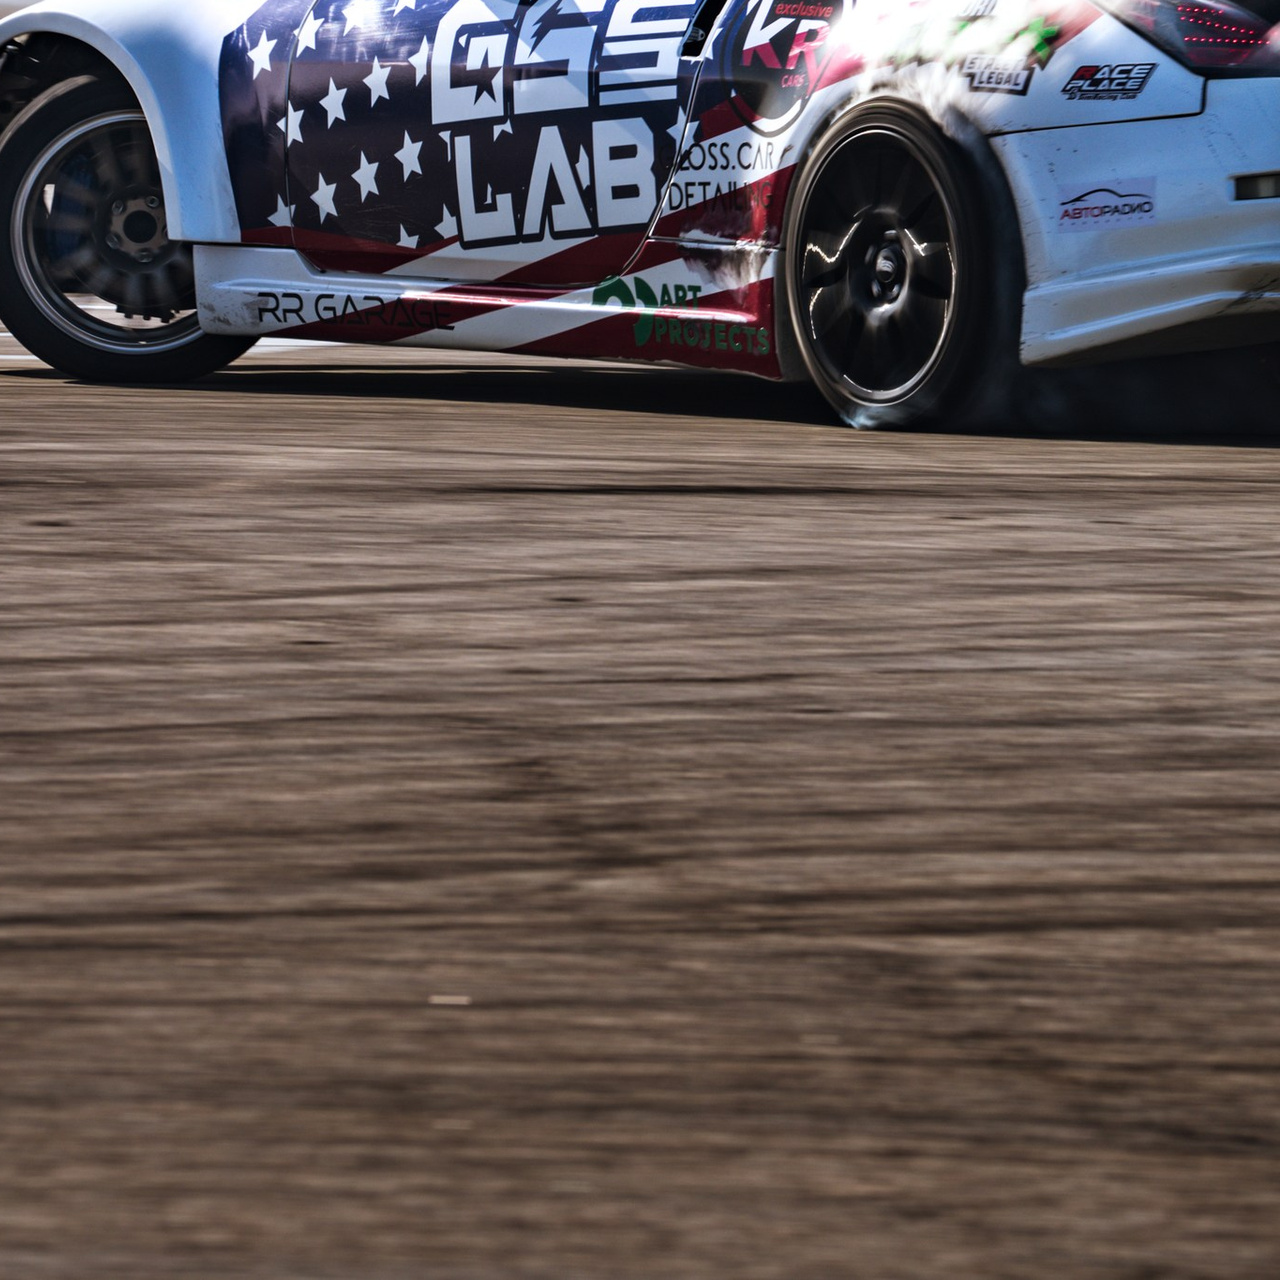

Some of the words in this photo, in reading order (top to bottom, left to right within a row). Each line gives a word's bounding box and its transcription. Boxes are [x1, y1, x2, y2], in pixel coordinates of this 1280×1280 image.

[775, 2, 834, 18] exclusive
[781, 75, 804, 88] CARS
[977, 70, 1021, 87] LEGAL
[1073, 64, 1153, 80] RACE
[1064, 79, 1143, 91] PLACE
[454, 117, 656, 242] LAB
[668, 181, 772, 211] DETAILING
[660, 284, 702, 310] ART
[257, 292, 306, 323] RR
[314, 294, 455, 330] GARAGE
[655, 317, 770, 355] PROJECTS
